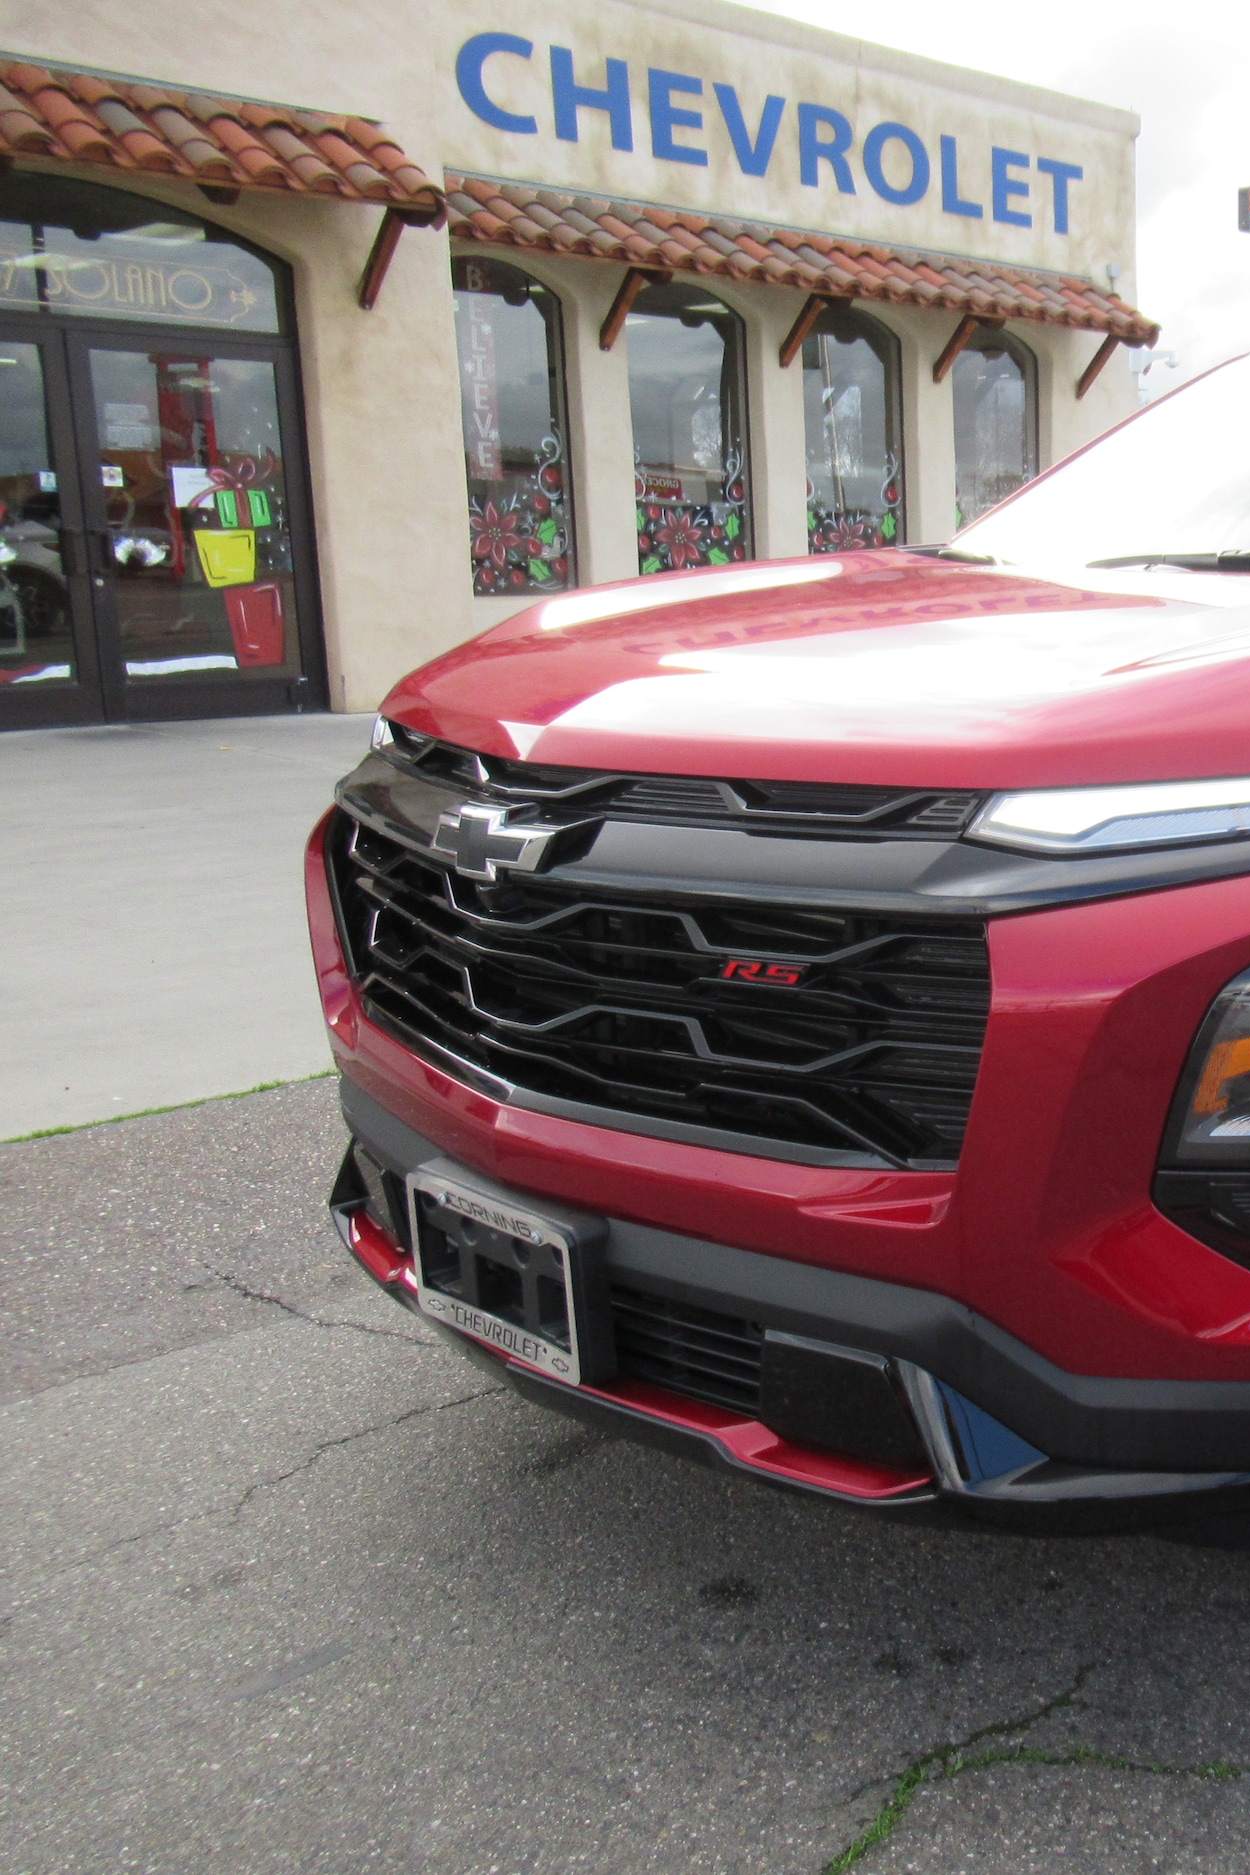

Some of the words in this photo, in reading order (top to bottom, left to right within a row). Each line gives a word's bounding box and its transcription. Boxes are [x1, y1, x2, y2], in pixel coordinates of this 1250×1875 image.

[455, 31, 1083, 235] CHEVROLET
[466, 264, 494, 469] BELIEVE
[722, 960, 805, 985] RS
[446, 1190, 533, 1238] CORNING
[454, 1306, 542, 1361] CHEVROLET
